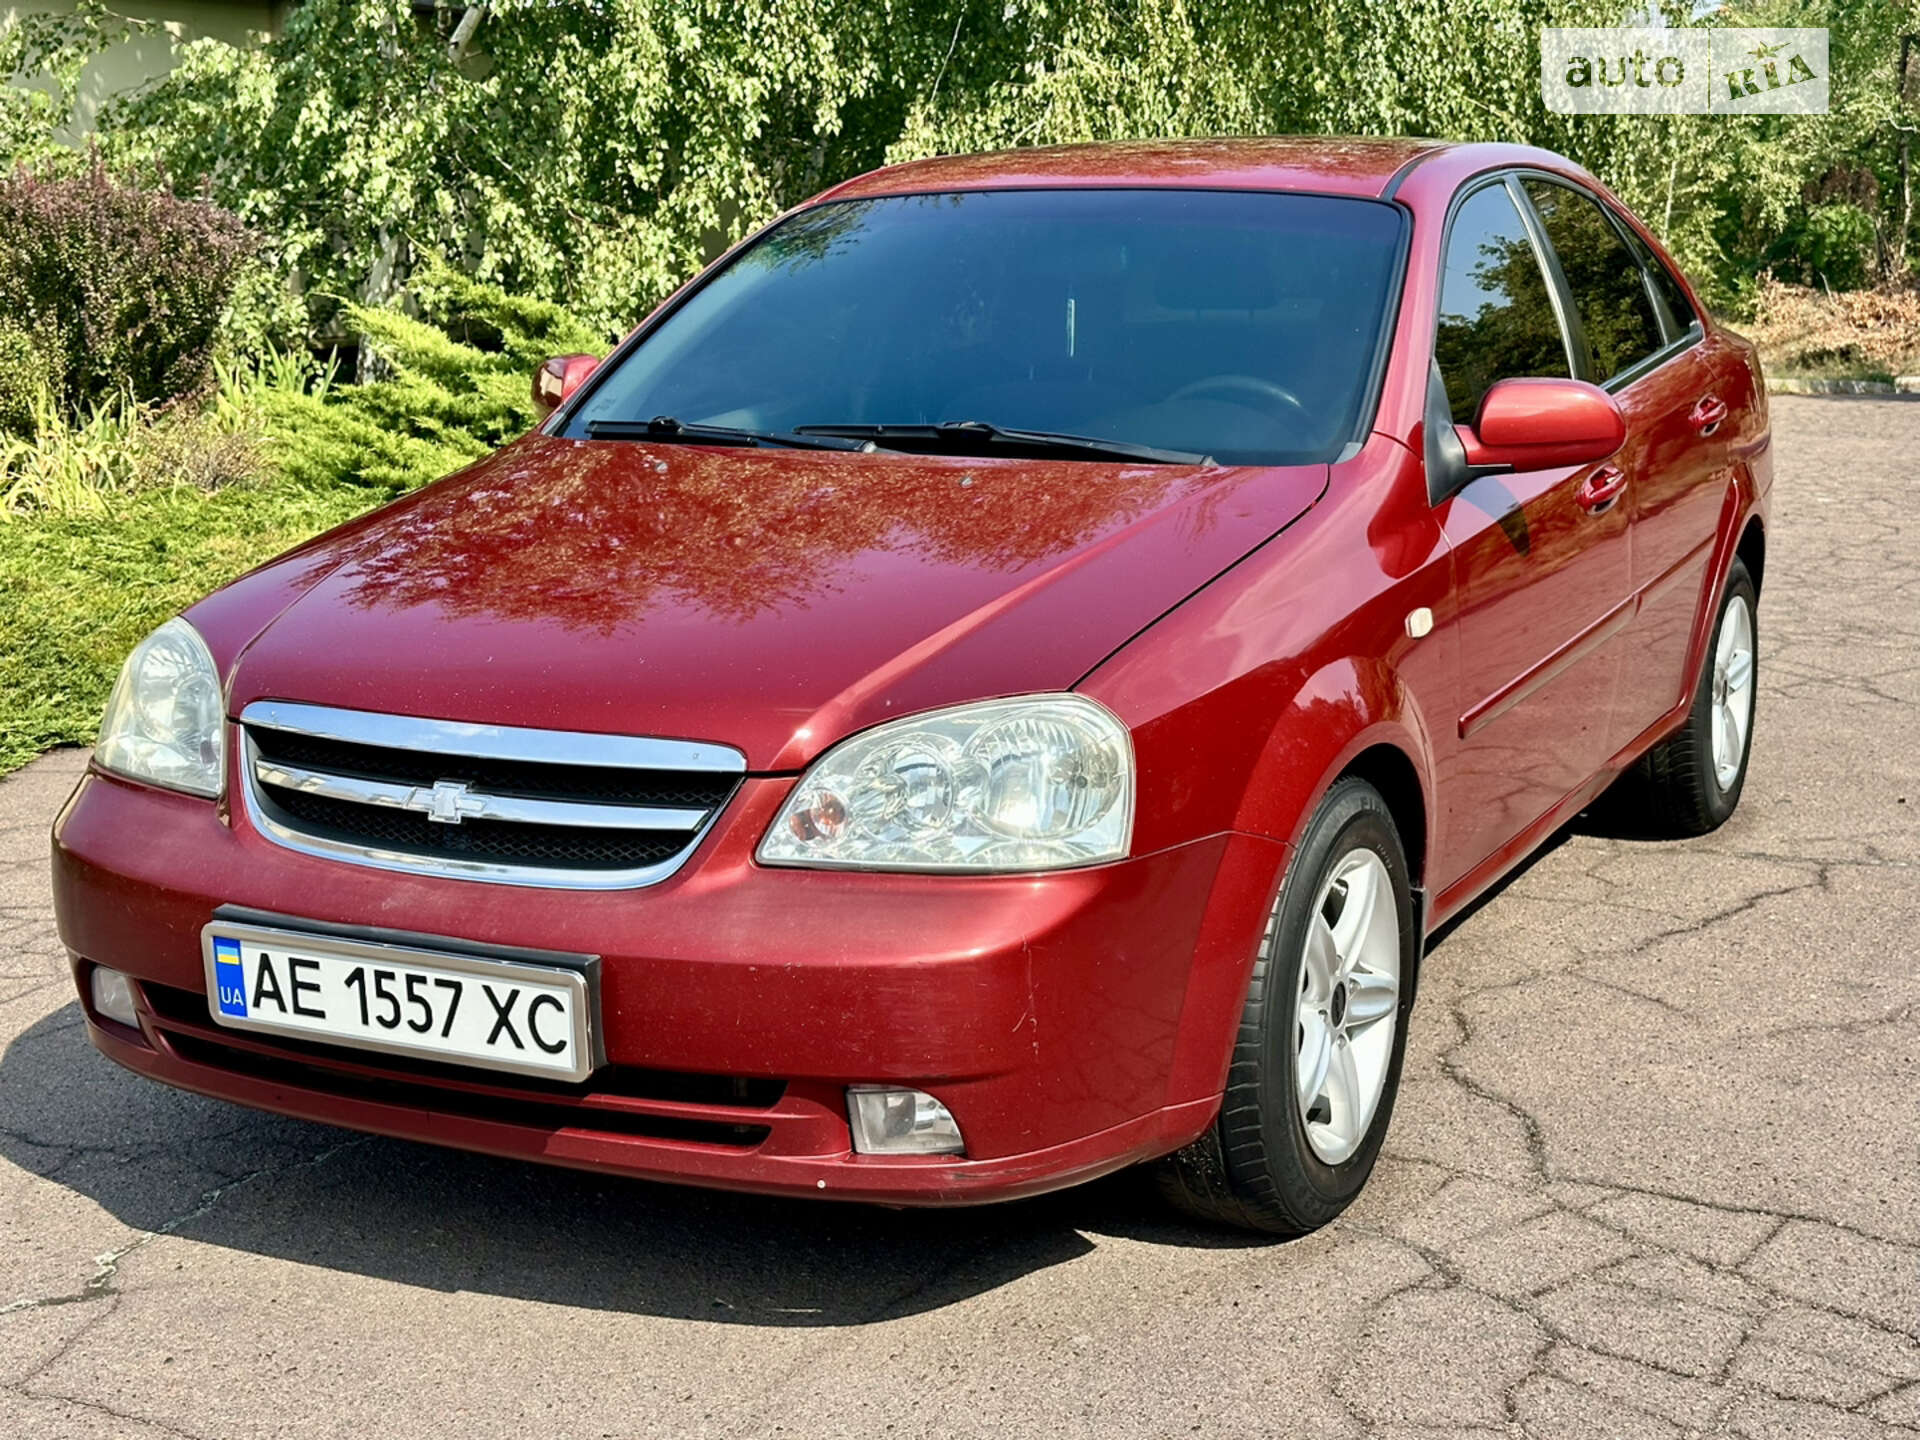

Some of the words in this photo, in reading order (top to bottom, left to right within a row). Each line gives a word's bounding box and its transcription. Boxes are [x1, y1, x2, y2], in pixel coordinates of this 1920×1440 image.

[220, 986, 244, 1007] UA
[252, 952, 326, 1020] AE
[344, 966, 463, 1039] 1557
[481, 983, 568, 1054] XC
